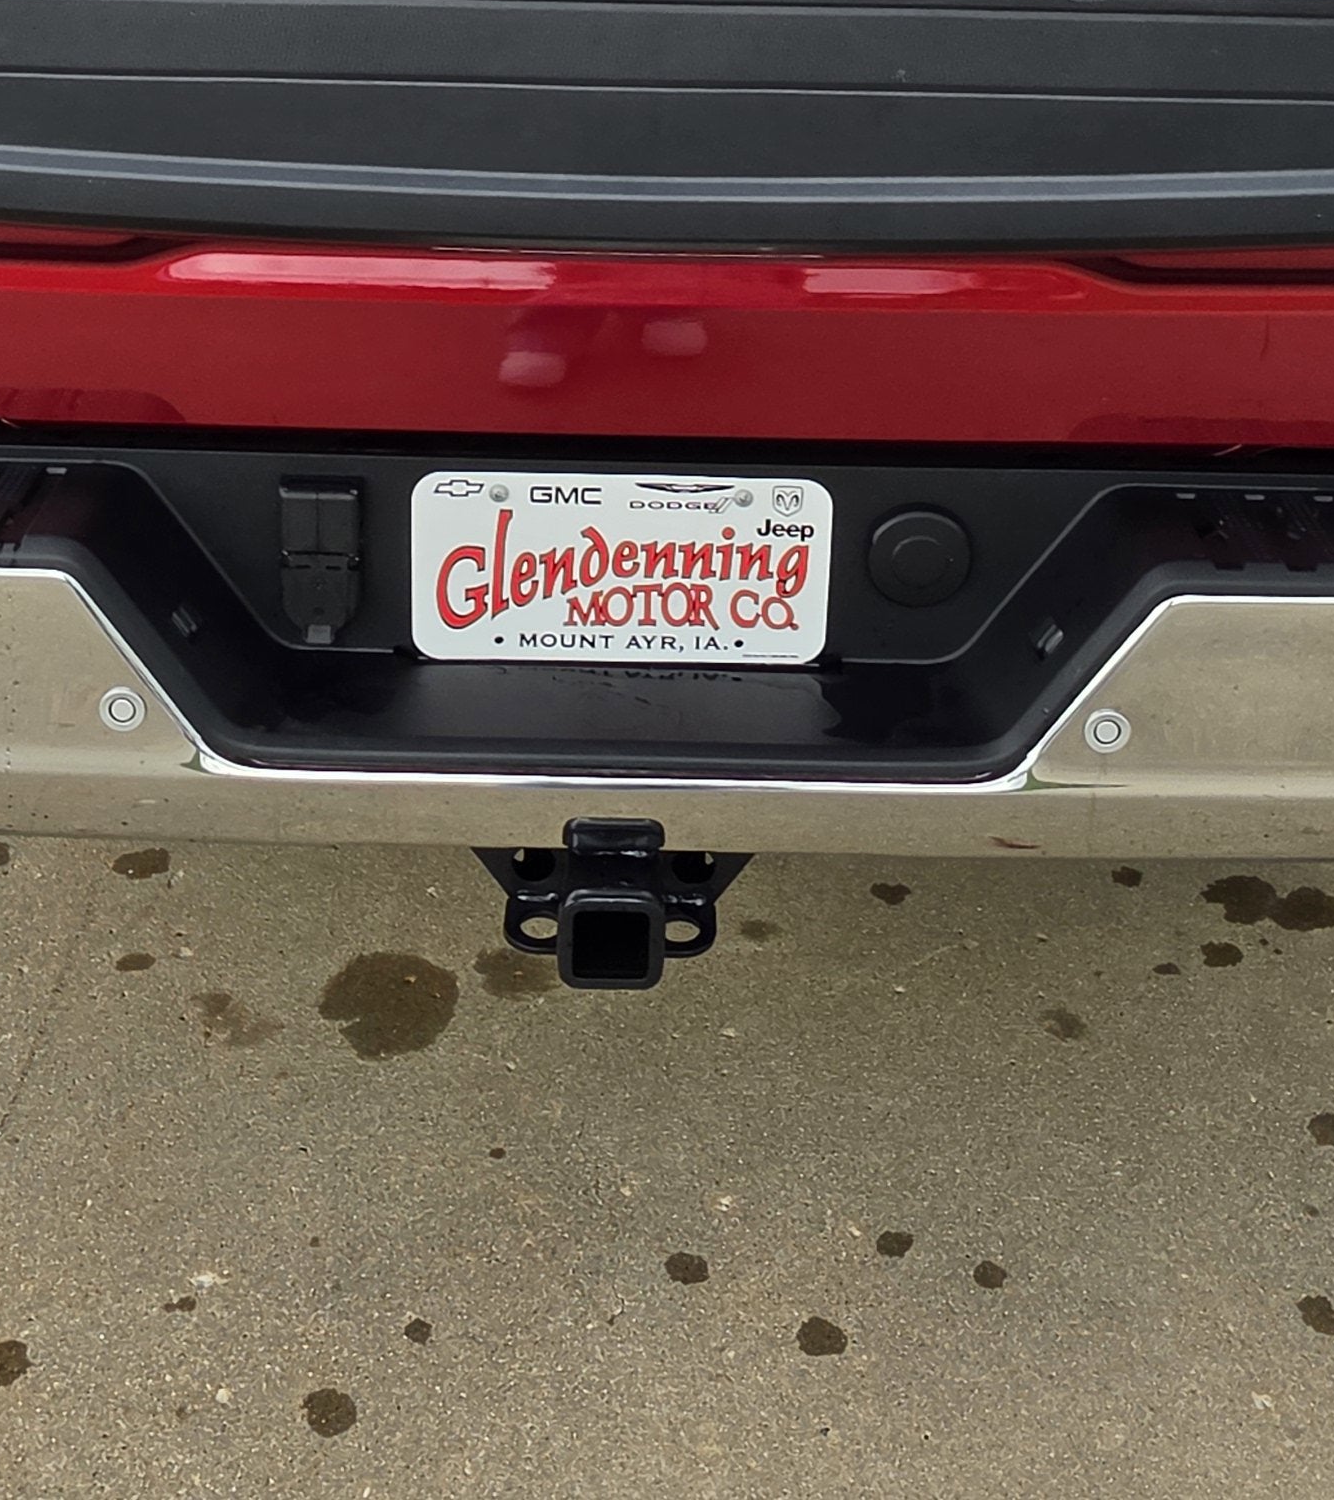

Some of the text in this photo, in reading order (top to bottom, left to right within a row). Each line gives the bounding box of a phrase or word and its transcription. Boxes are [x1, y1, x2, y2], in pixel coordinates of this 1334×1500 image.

[530, 486, 602, 505] GMC
[629, 501, 718, 511] DODGE
[756, 519, 815, 542] Jeep
[436, 508, 810, 629] Glendenning
[563, 582, 720, 631] MOTOR
[518, 633, 728, 652] MOUNT AYR, IA.
